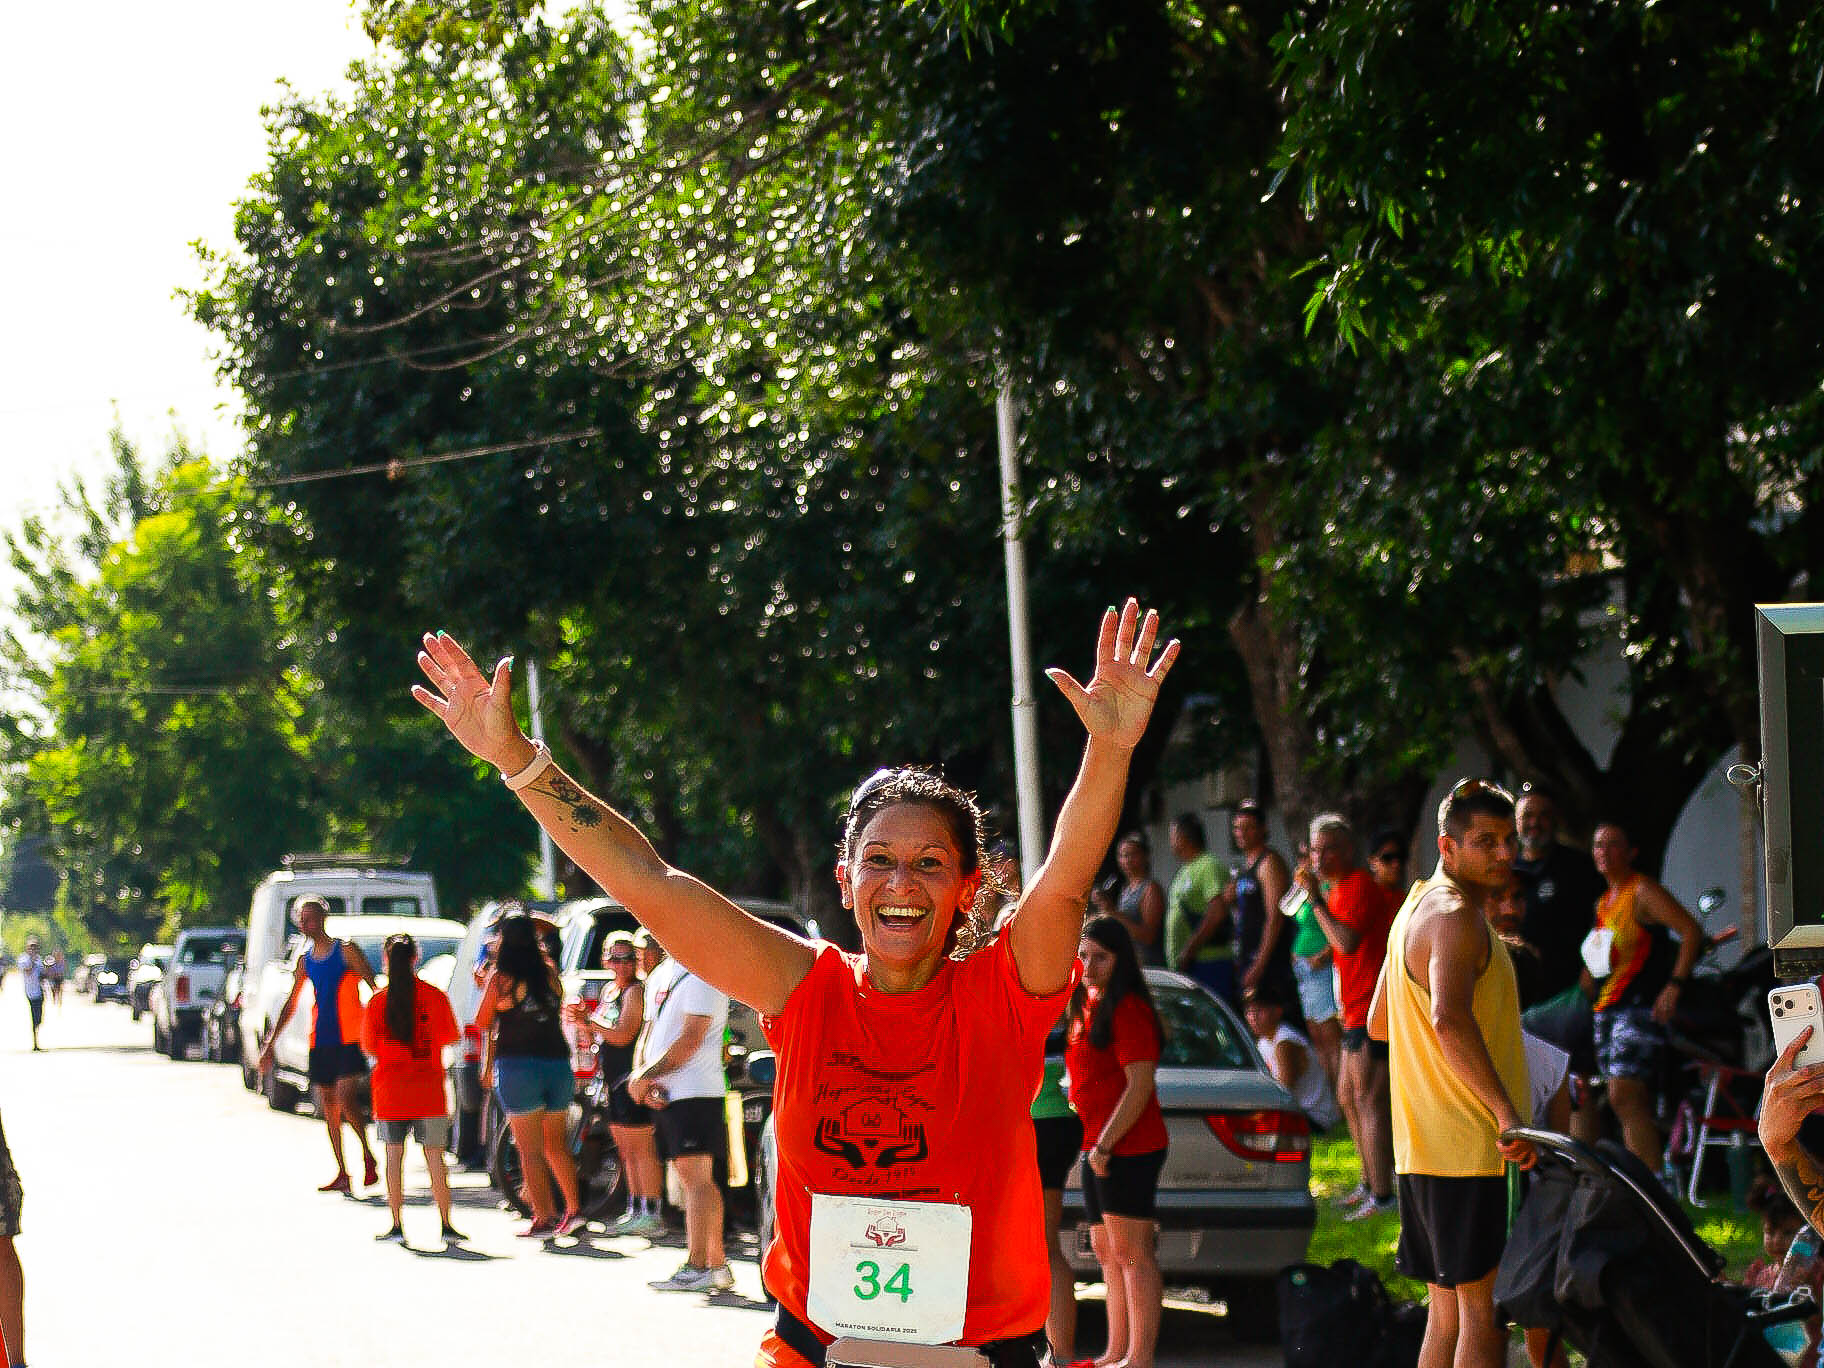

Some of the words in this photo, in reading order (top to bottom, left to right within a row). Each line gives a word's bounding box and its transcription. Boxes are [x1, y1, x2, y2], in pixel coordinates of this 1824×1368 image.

[854, 1260, 914, 1303] 34
[835, 1321, 866, 1331] MARATON
[867, 1324, 901, 1333] SOLIDARIA
